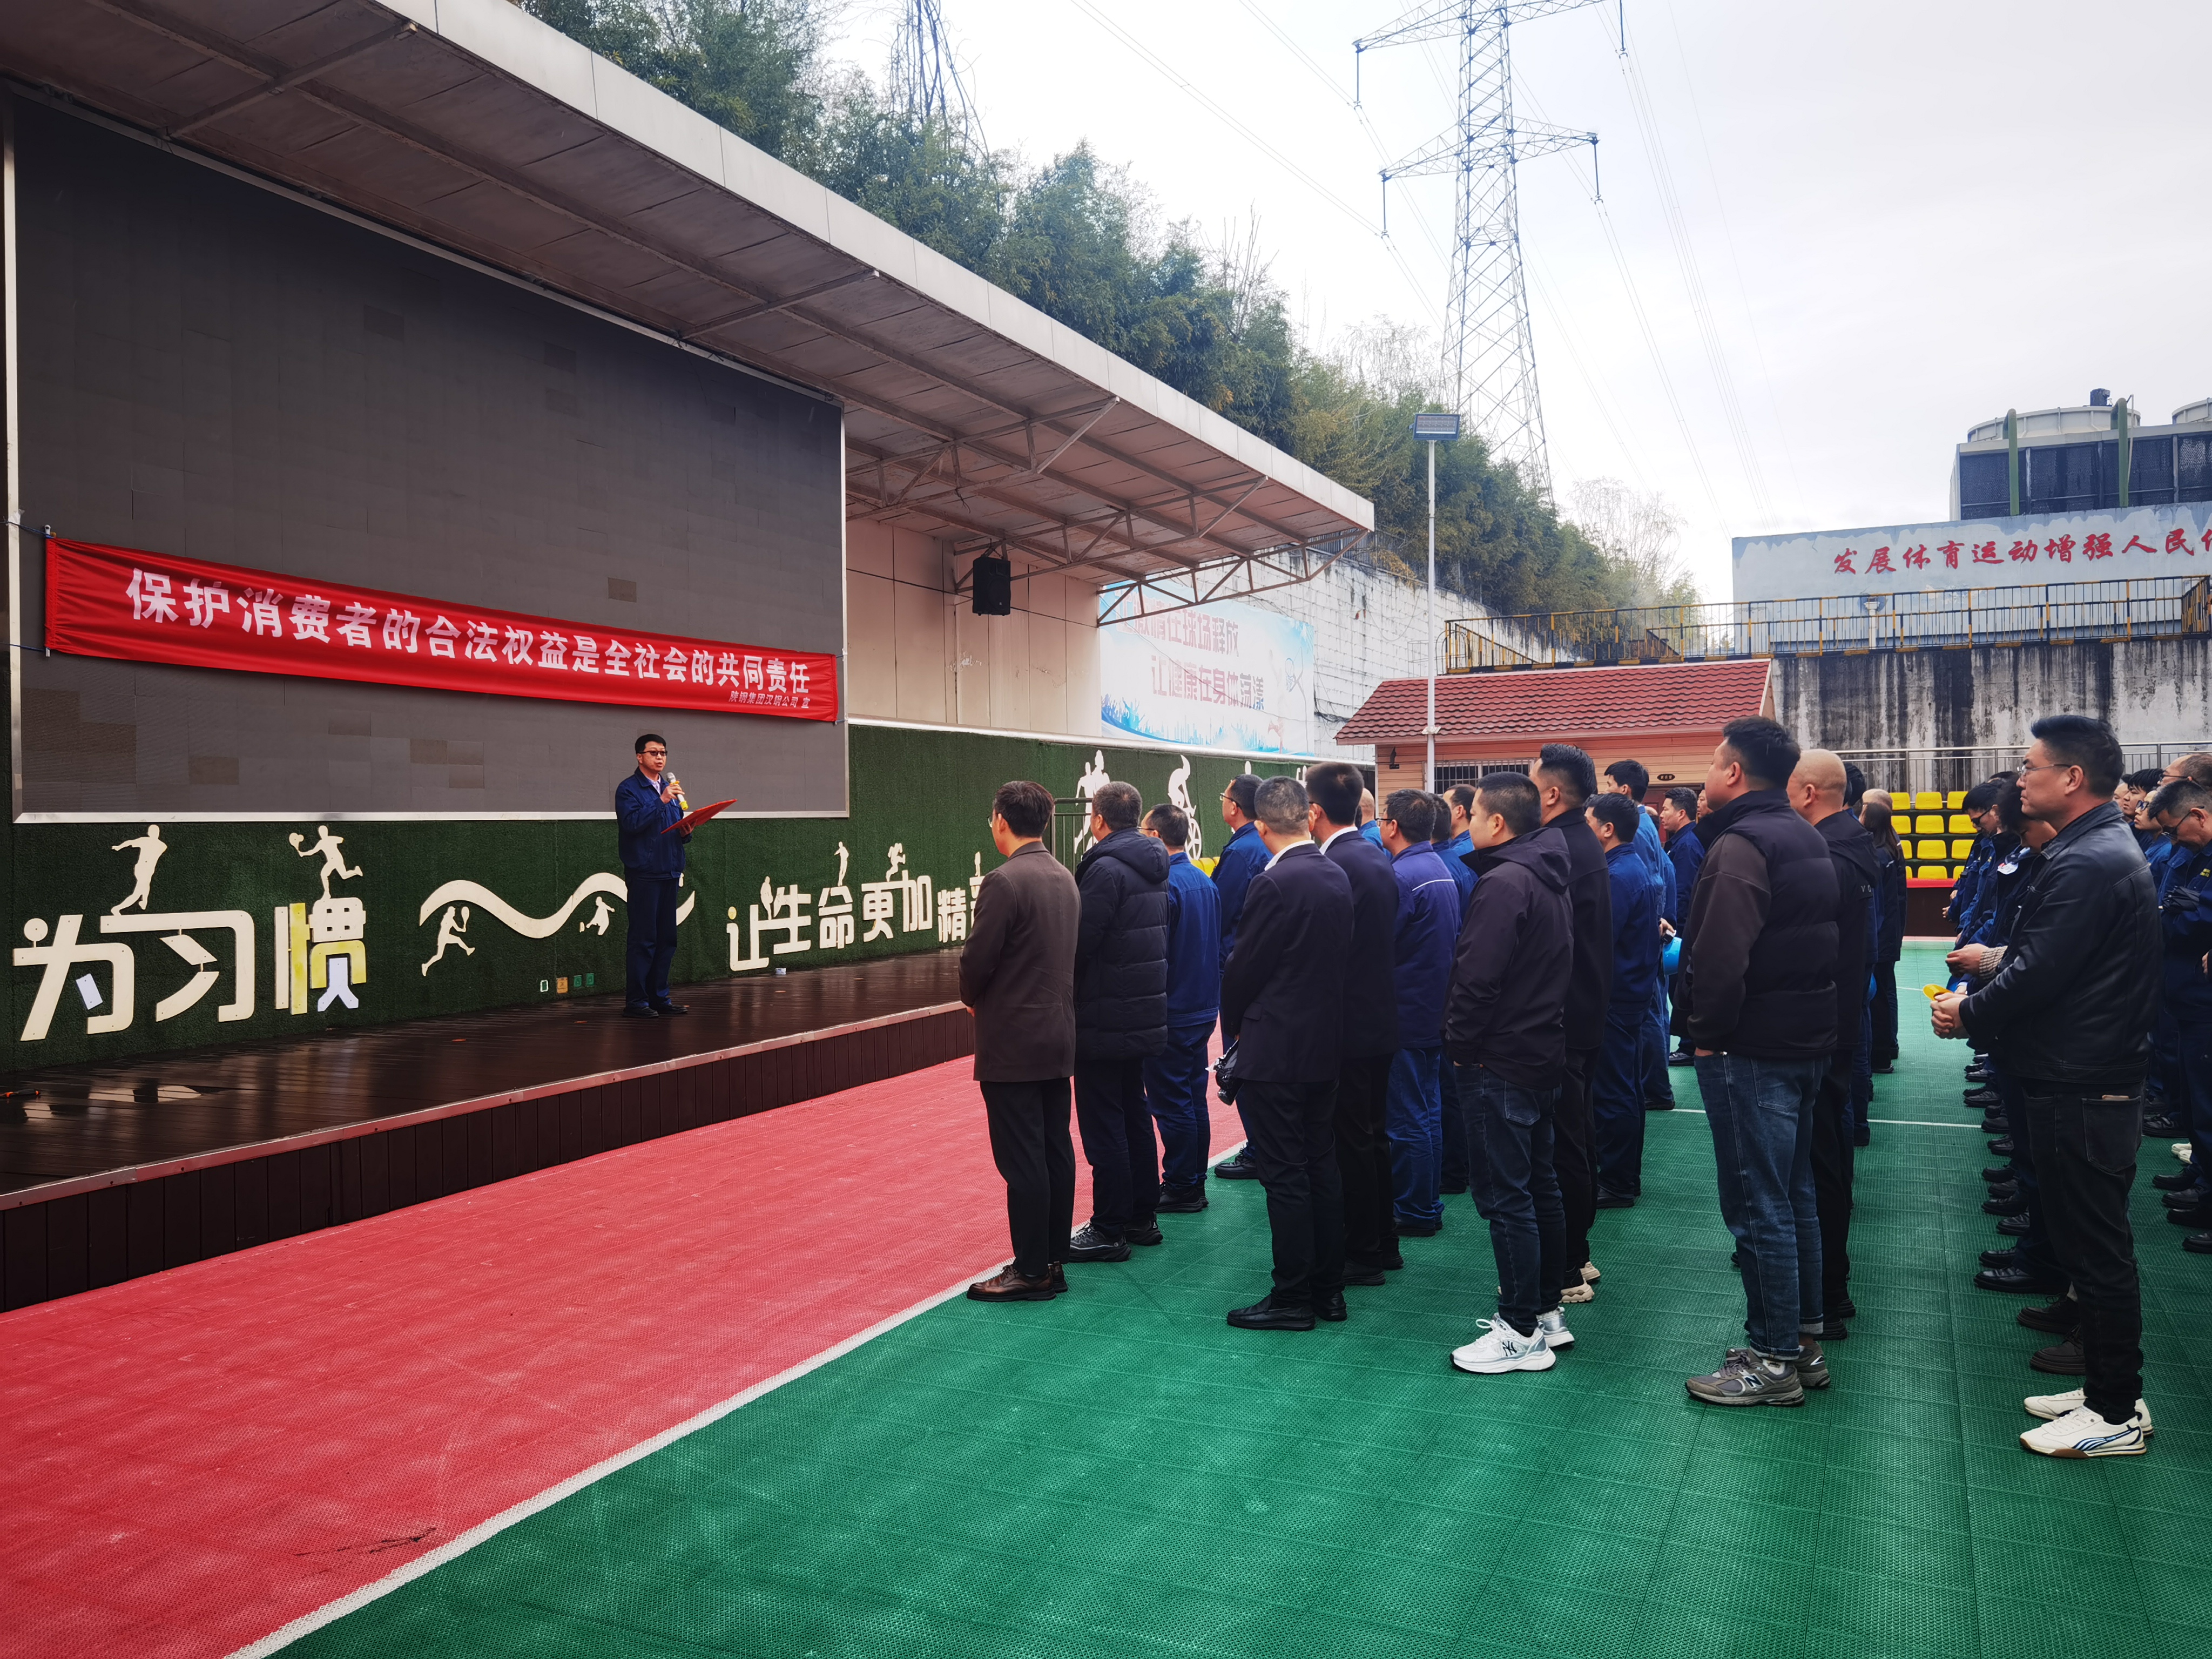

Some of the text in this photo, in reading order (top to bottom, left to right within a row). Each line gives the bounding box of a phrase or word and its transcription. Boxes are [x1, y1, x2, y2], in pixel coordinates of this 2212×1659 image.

[126, 567, 810, 694] 保护消费者的合法权益是全社会的共同责任
[1115, 589, 1239, 657] 让激情在球场释放
[729, 690, 811, 709] 陕钢集团汉钢公司 宣
[1151, 655, 1265, 710] 让健康在身体荡漾
[12, 897, 367, 1042] 为习惯
